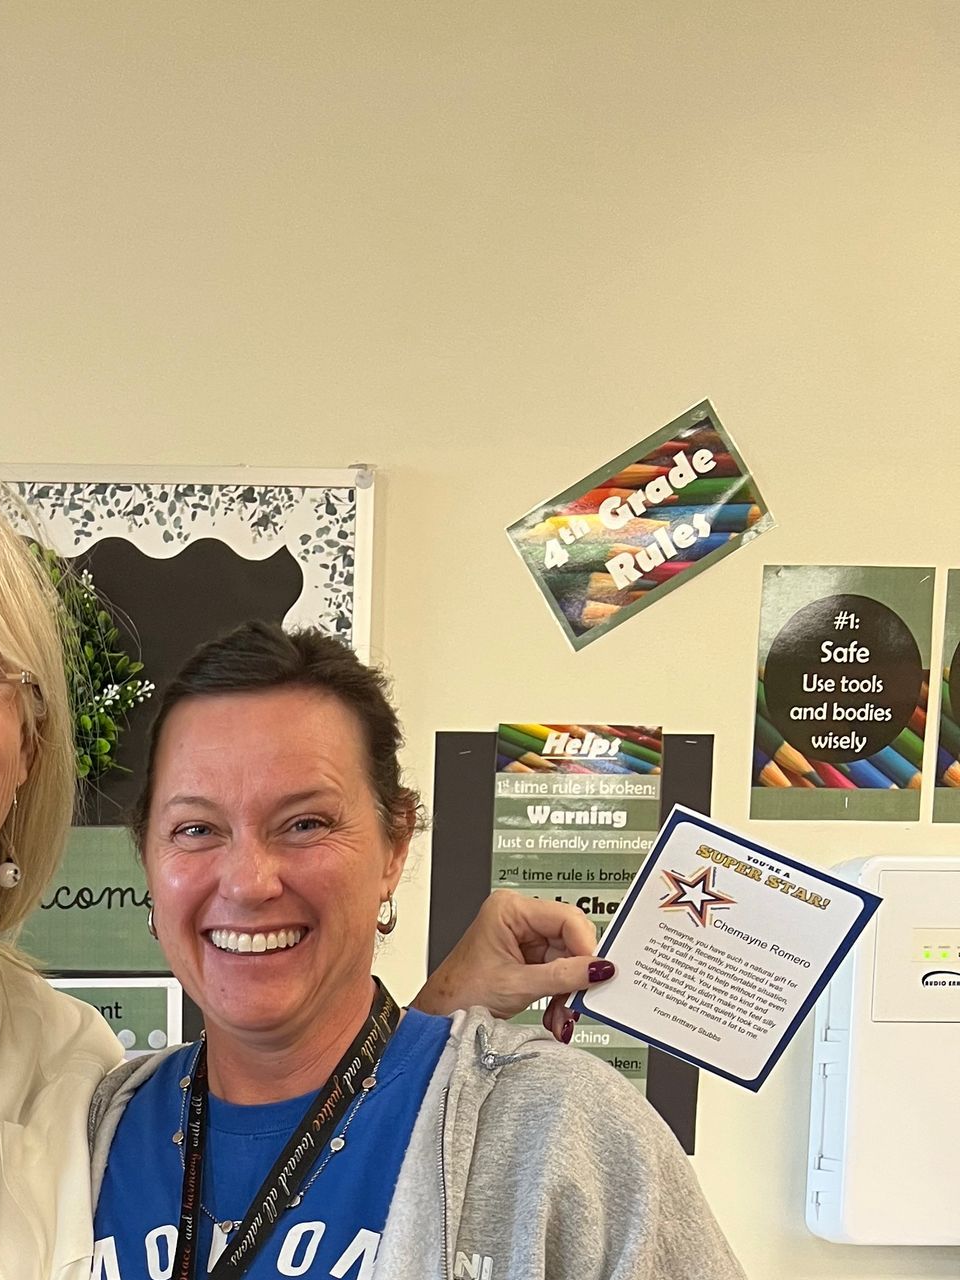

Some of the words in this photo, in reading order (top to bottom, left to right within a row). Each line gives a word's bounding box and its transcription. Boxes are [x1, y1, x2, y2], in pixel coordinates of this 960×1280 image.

[544, 518, 590, 570] 4th
[599, 448, 717, 530] Grade
[605, 513, 711, 591] Rules
[834, 611, 860, 630] #1:
[820, 640, 870, 664] Safe
[802, 673, 835, 692] Use
[840, 675, 884, 693] tools
[790, 703, 828, 721] and
[833, 703, 892, 721] bodies
[542, 731, 622, 759] Helps
[811, 731, 867, 753] wisely
[514, 780, 548, 794] time
[552, 780, 582, 794] rule
[586, 781, 596, 794] is
[600, 780, 656, 795] broken:
[527, 805, 628, 828] Warning
[497, 835, 522, 849] Just
[525, 838, 535, 849] a
[539, 835, 589, 851] friendly
[592, 836, 653, 850] reminder
[498, 867, 519, 881] 2nd
[522, 869, 553, 881] time
[557, 868, 583, 881] rule
[587, 869, 595, 881] is
[695, 844, 763, 882] SUPER
[763, 874, 832, 911] STAR!
[674, 949, 689, 959] call
[713, 919, 768, 950] Chemayne
[769, 944, 811, 969] Romero
[643, 945, 659, 955] and
[657, 951, 671, 961] you
[670, 957, 700, 974] stepped
[698, 969, 706, 977] in
[706, 972, 714, 981] to
[714, 975, 730, 988] help
[730, 984, 756, 1000] without
[755, 996, 768, 1005] me
[767, 1001, 785, 1013] even
[694, 939, 709, 949] you
[708, 944, 726, 957] have
[726, 953, 744, 965] such
[749, 963, 775, 978] natural
[773, 975, 787, 984] gift
[786, 979, 798, 989] for
[724, 962, 739, 972] you
[738, 968, 766, 984] noticed
[768, 982, 784, 992] was
[633, 969, 642, 977] or
[686, 993, 700, 1004] you
[698, 999, 714, 1010] just
[713, 1006, 737, 1021] quietly
[736, 1016, 753, 1027] took
[752, 1024, 769, 1034] care
[651, 957, 675, 974] having
[674, 968, 683, 976] to
[698, 978, 712, 990] You
[712, 985, 729, 997] were
[728, 993, 739, 1001] so
[738, 996, 755, 1009] kind
[753, 1005, 769, 1015] and
[670, 976, 685, 987] and
[683, 983, 698, 993] you
[716, 997, 737, 1010] make
[735, 1006, 748, 1016] me
[748, 1011, 763, 1022] feel
[761, 1018, 777, 1029] silly
[650, 985, 666, 997] That
[665, 993, 689, 1008] simple
[688, 1004, 701, 1013] act
[699, 1009, 723, 1023] meant
[727, 1021, 738, 1030] lot
[737, 1026, 746, 1034] to
[653, 1006, 672, 1019] From
[671, 1015, 698, 1032] Brittany
[697, 1027, 722, 1042] Stubbs
[343, 1056, 361, 1092] and
[312, 1074, 345, 1129] justice
[189, 1121, 201, 1147] with
[278, 1132, 315, 1191] toward
[183, 1153, 201, 1210] harmony
[262, 1187, 278, 1223] all
[181, 1215, 193, 1240] and
[230, 1212, 263, 1266] nations.
